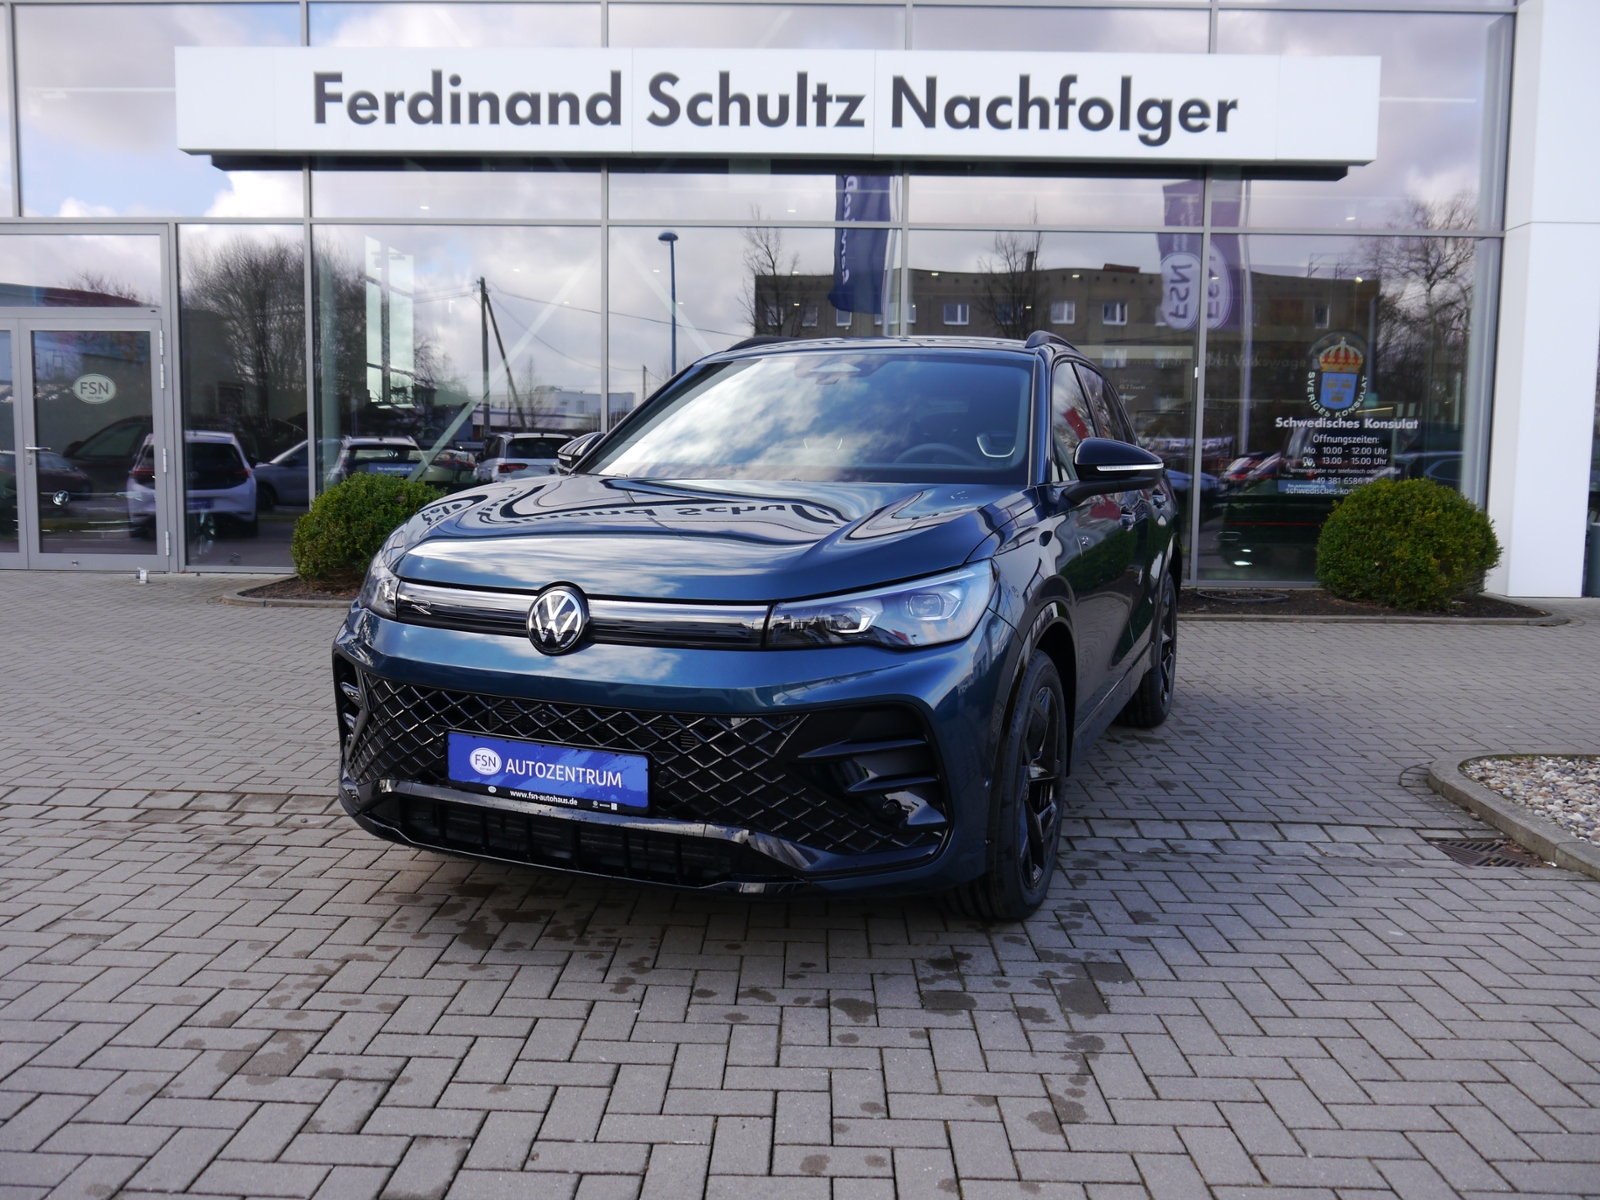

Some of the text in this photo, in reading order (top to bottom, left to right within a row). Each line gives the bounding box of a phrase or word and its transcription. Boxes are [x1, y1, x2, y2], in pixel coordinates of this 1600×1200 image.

[313, 69, 1239, 147] Ferdinand Schultz Nachfolger
[80, 381, 109, 395] FSN
[1307, 371, 1368, 418] SVERIGES KONSULAT
[1275, 417, 1418, 429] Schwedisches Konsulat
[1313, 434, 1380, 445] Öffnungszeiten:
[1351, 447, 1372, 455] 12.00
[1374, 447, 1388, 455] Uhr
[1322, 457, 1342, 465] 13.00
[1351, 457, 1372, 465] 15.00
[1373, 457, 1387, 465] Uhr
[1344, 477, 1362, 485] 6586
[475, 754, 622, 788] FSN AUTOZENTRUM
[510, 790, 578, 805] www.fsn-autohaus.de
